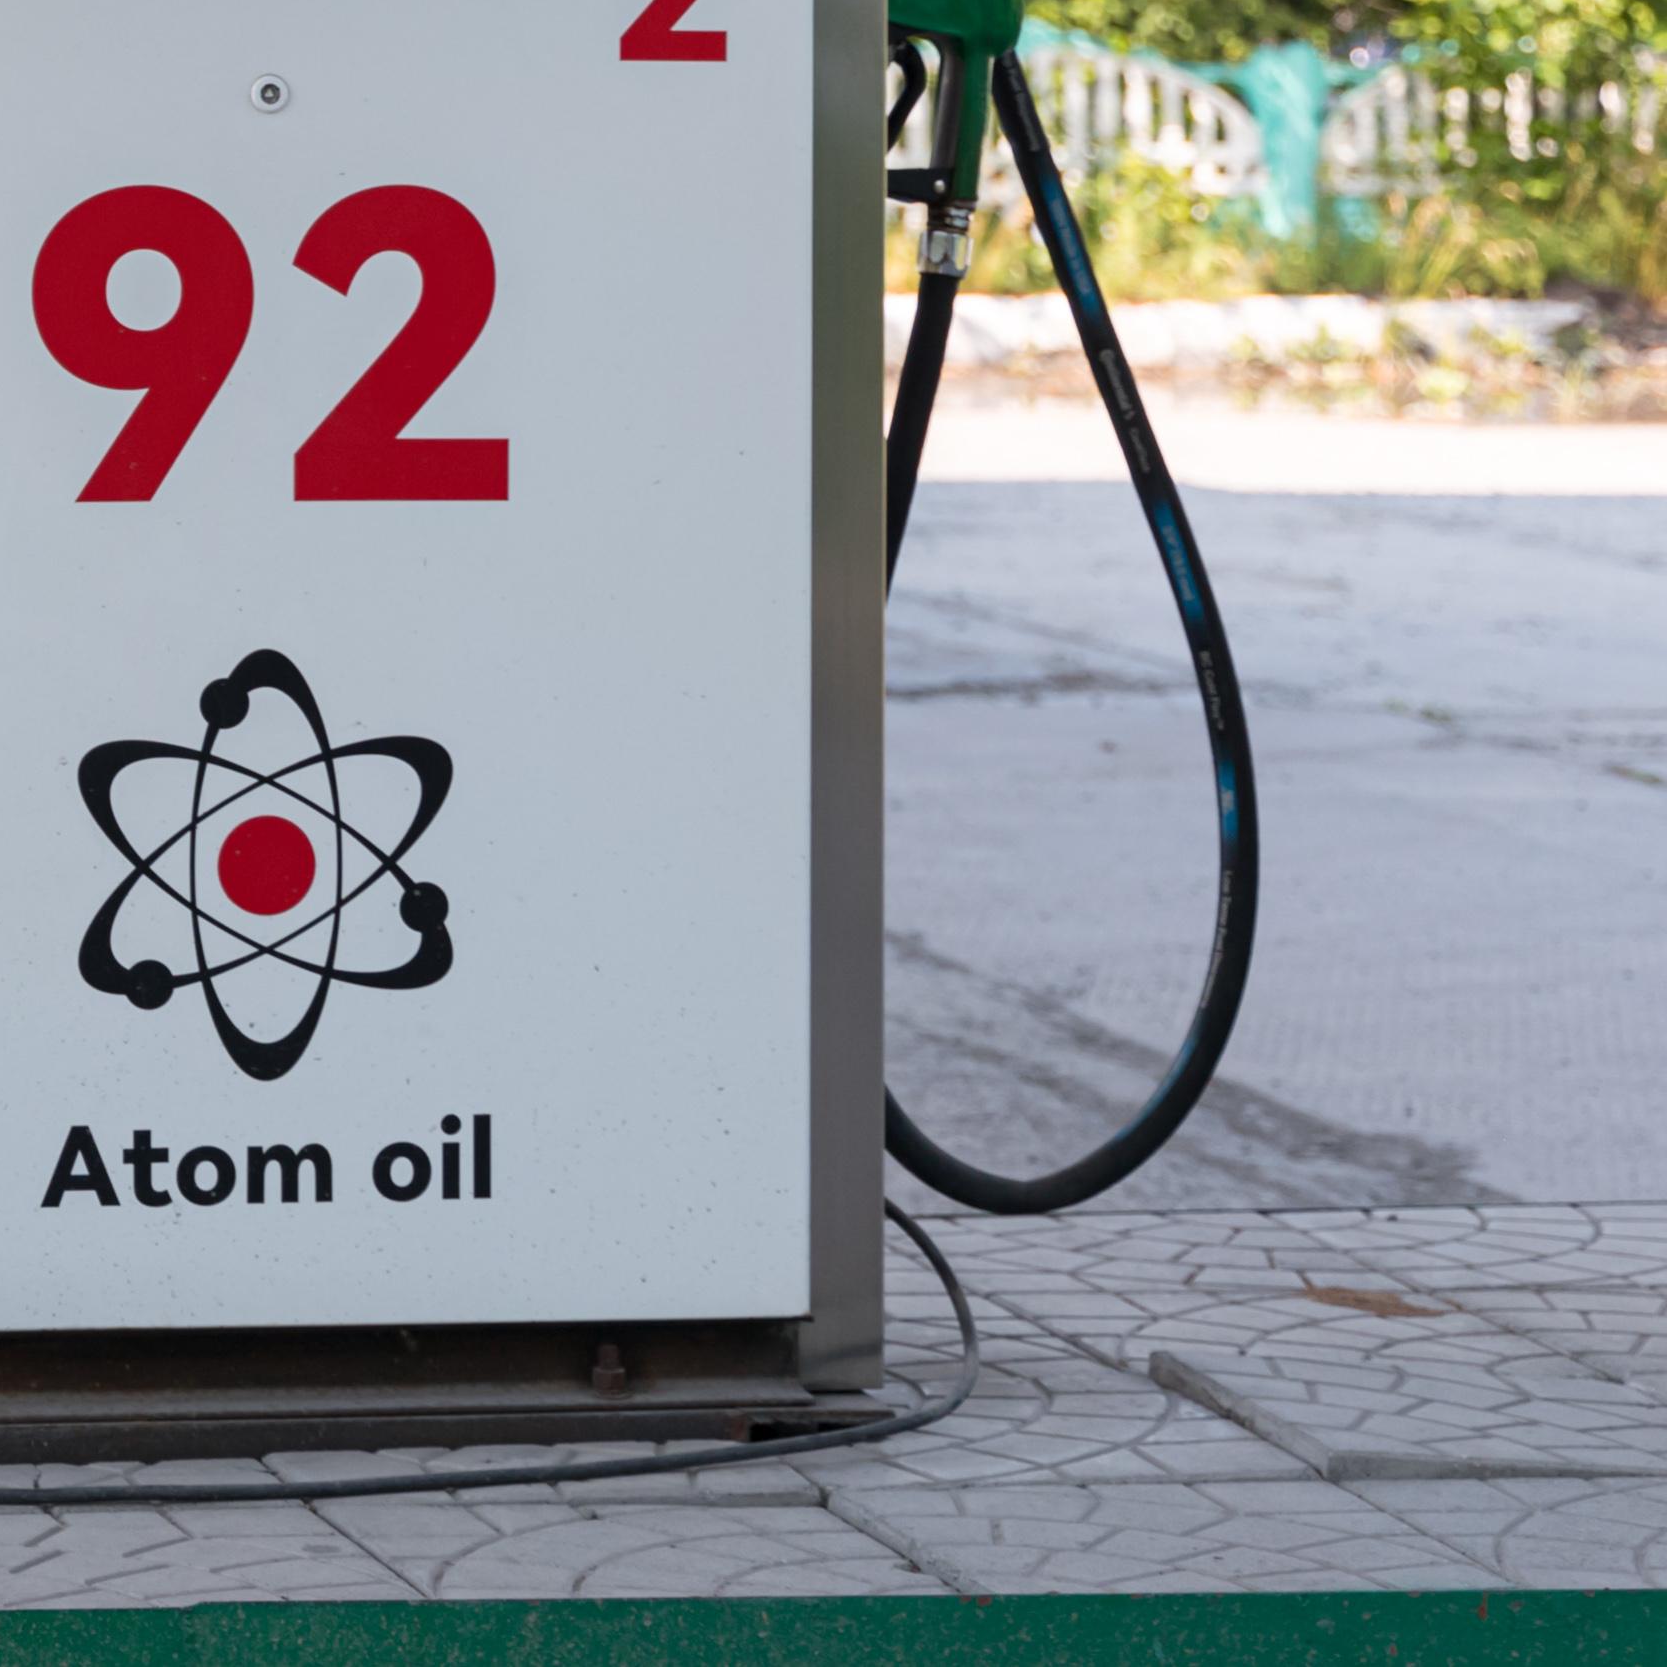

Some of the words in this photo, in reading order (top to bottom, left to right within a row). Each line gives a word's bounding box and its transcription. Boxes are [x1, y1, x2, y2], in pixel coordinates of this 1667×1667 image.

[31, 184, 510, 503] 92
[40, 1124, 334, 1209] Atom
[370, 1113, 493, 1204] oil
